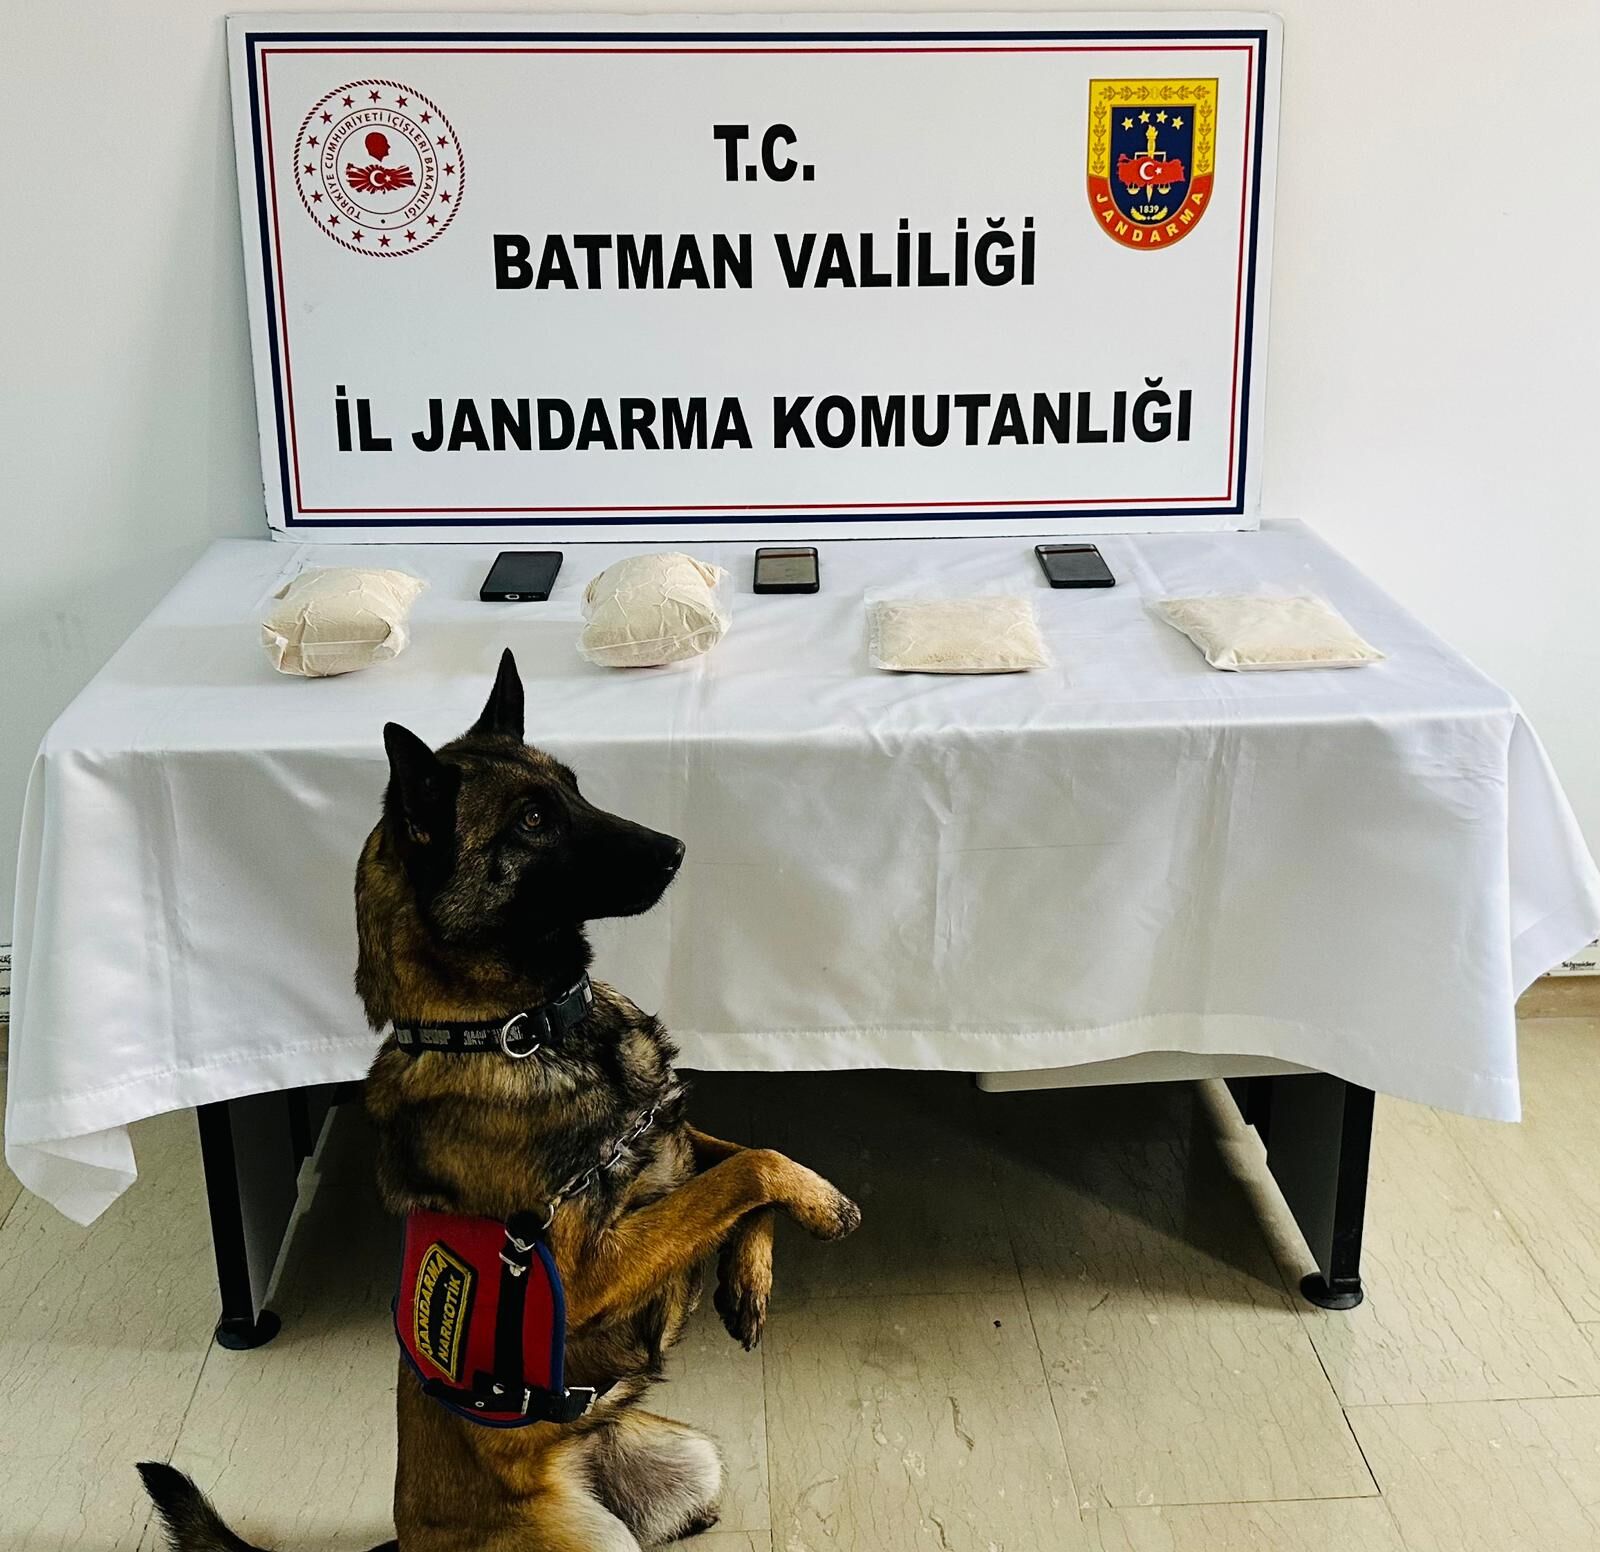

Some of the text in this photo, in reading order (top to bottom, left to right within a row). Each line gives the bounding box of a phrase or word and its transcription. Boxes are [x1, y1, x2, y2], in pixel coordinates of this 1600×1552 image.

[325, 112, 434, 220] TÜRKİYE CUMHURİYETİ İÇİŞLERİ BAKANLIĞI
[713, 123, 816, 182] T.C.
[1096, 192, 1203, 243] JANDARMA
[1139, 205, 1159, 214] 1839
[493, 216, 1036, 290] BATMAN VALİLİĞİ
[335, 376, 1193, 452] İL JANDARMA KOMUTANLIĞI
[418, 1253, 448, 1355] JANDARMA
[438, 1273, 461, 1363] NARKOTİK
